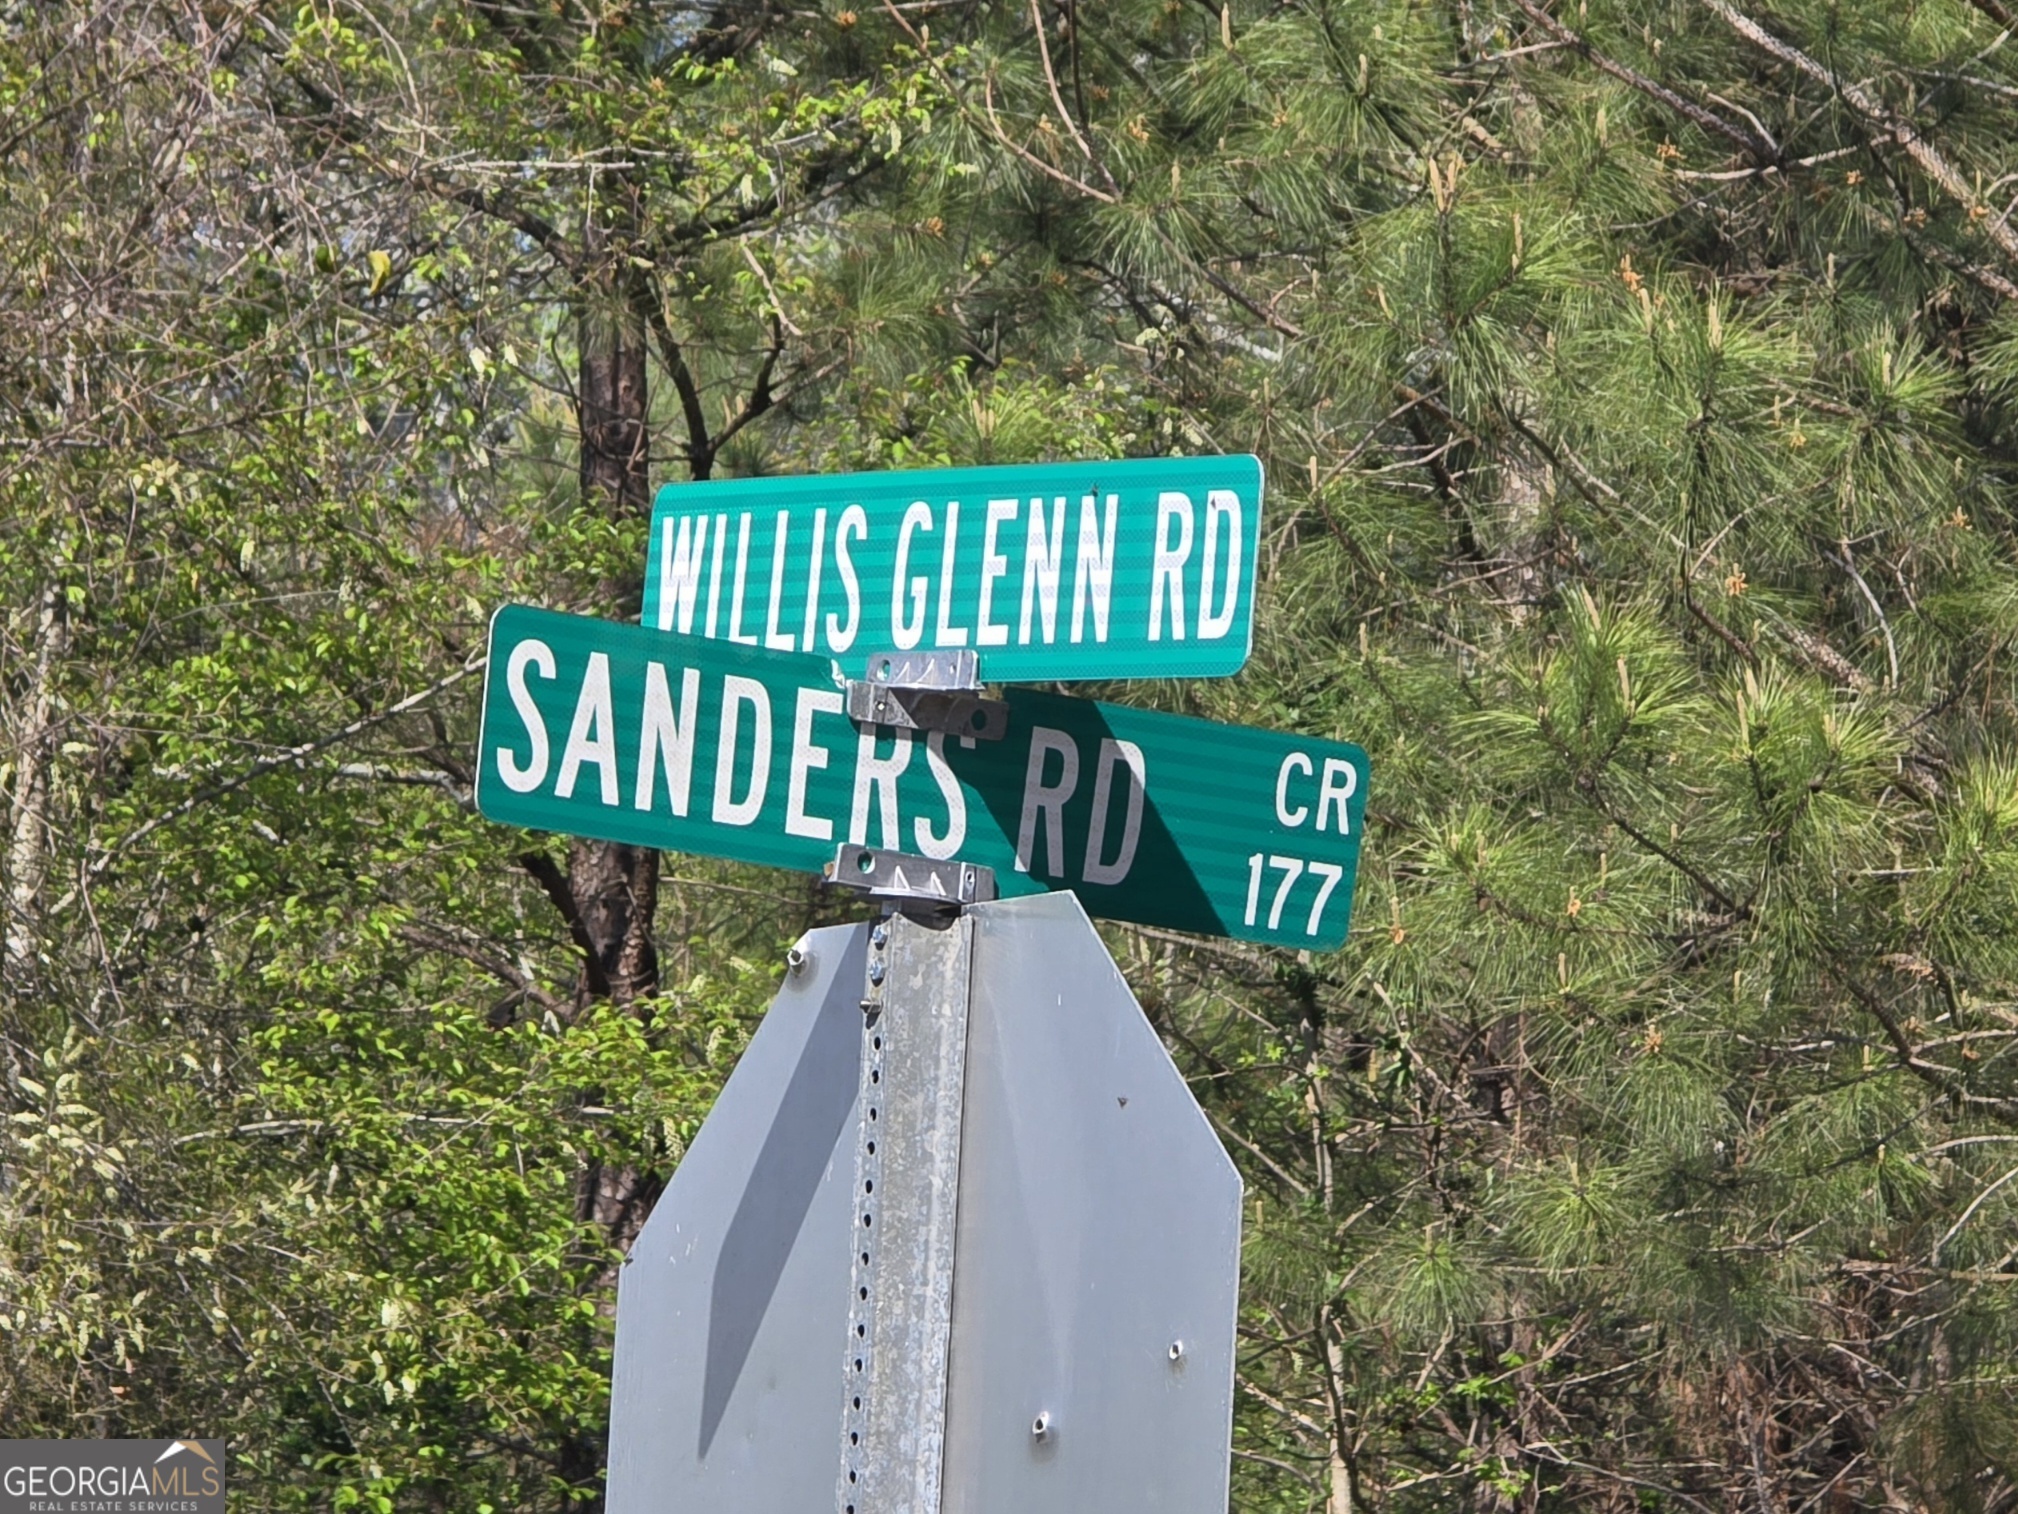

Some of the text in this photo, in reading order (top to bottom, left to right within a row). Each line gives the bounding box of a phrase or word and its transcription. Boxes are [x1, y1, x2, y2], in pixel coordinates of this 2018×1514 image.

[657, 489, 1243, 653] WILLIS GLENN RD
[497, 638, 1146, 885] SANDERS RD
[1275, 752, 1358, 836] CR
[1244, 853, 1343, 937] 177
